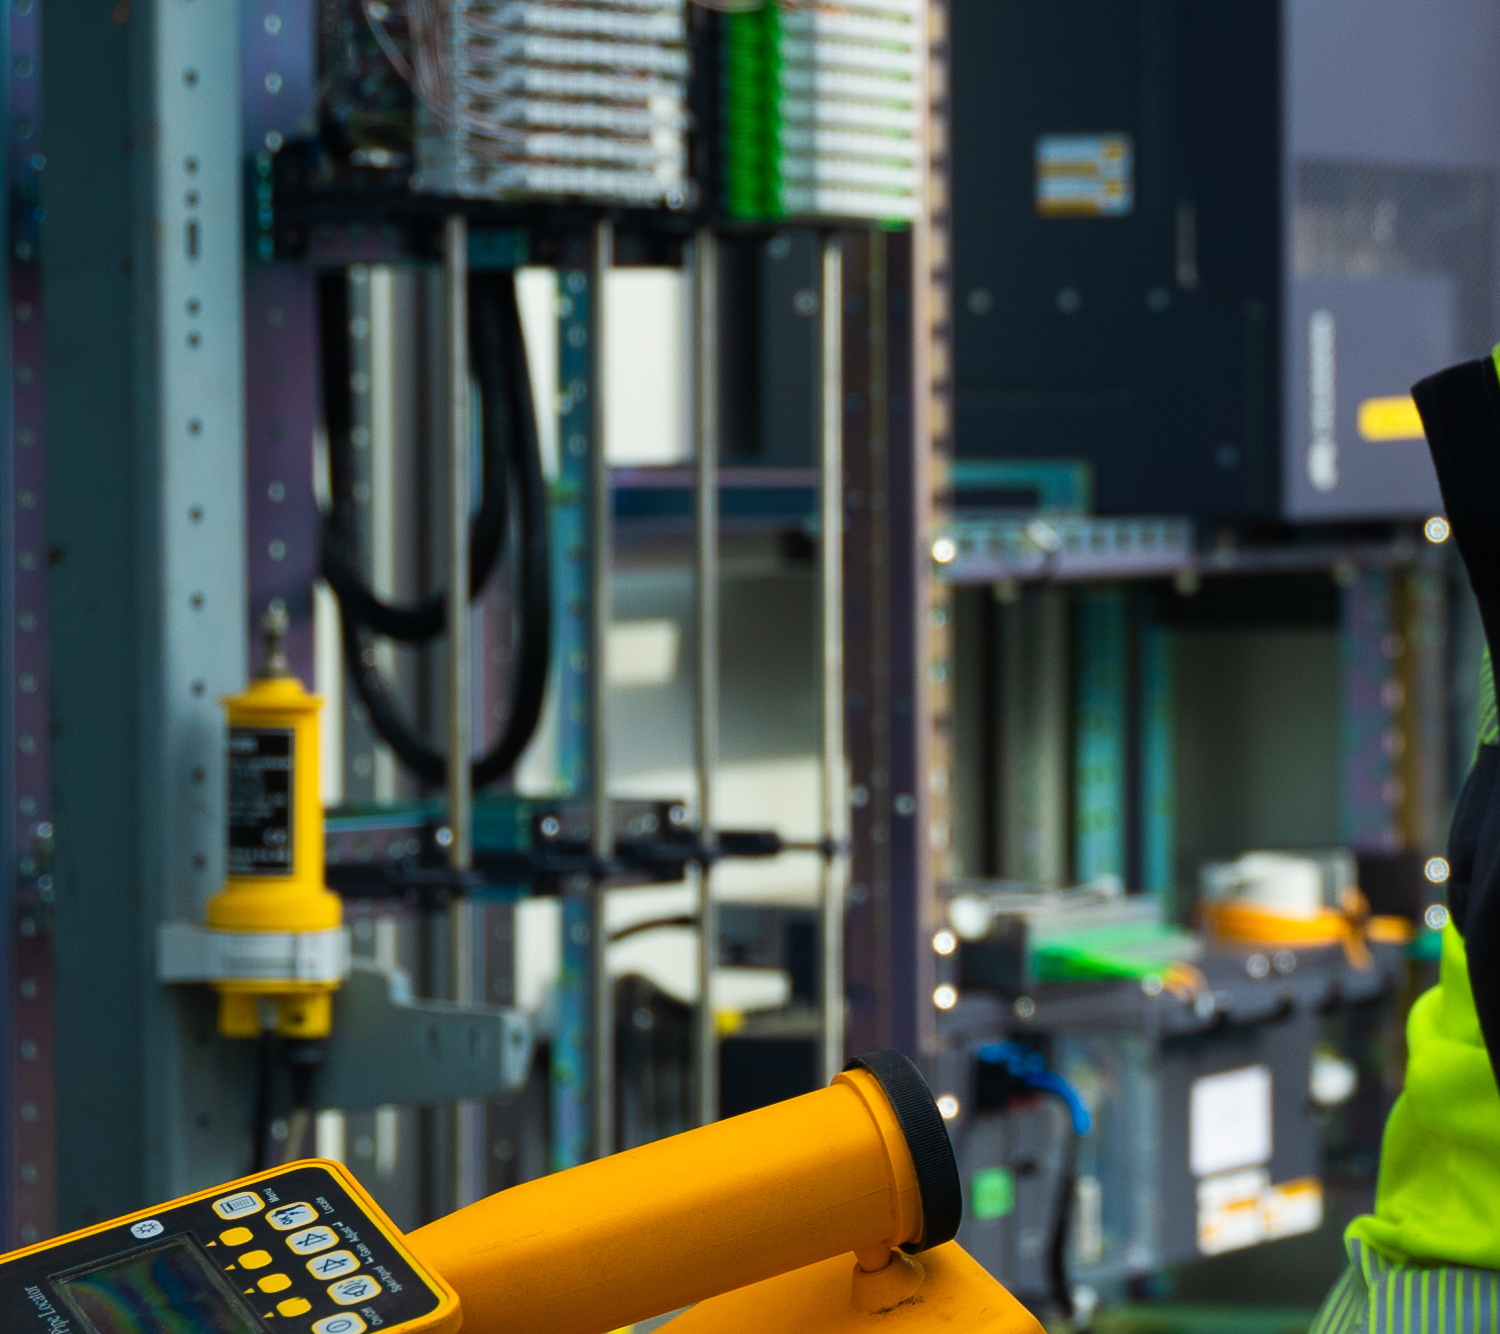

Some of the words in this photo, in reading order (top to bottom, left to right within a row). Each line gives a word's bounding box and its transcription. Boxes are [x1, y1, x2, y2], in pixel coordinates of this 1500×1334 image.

[263, 1187, 280, 1203] Menu
[315, 1196, 335, 1214] Locate
[341, 1226, 361, 1242] Adjust
[356, 1243, 372, 1257] Gain
[24, 1285, 56, 1318] Locator
[360, 1306, 384, 1326] On/Off
